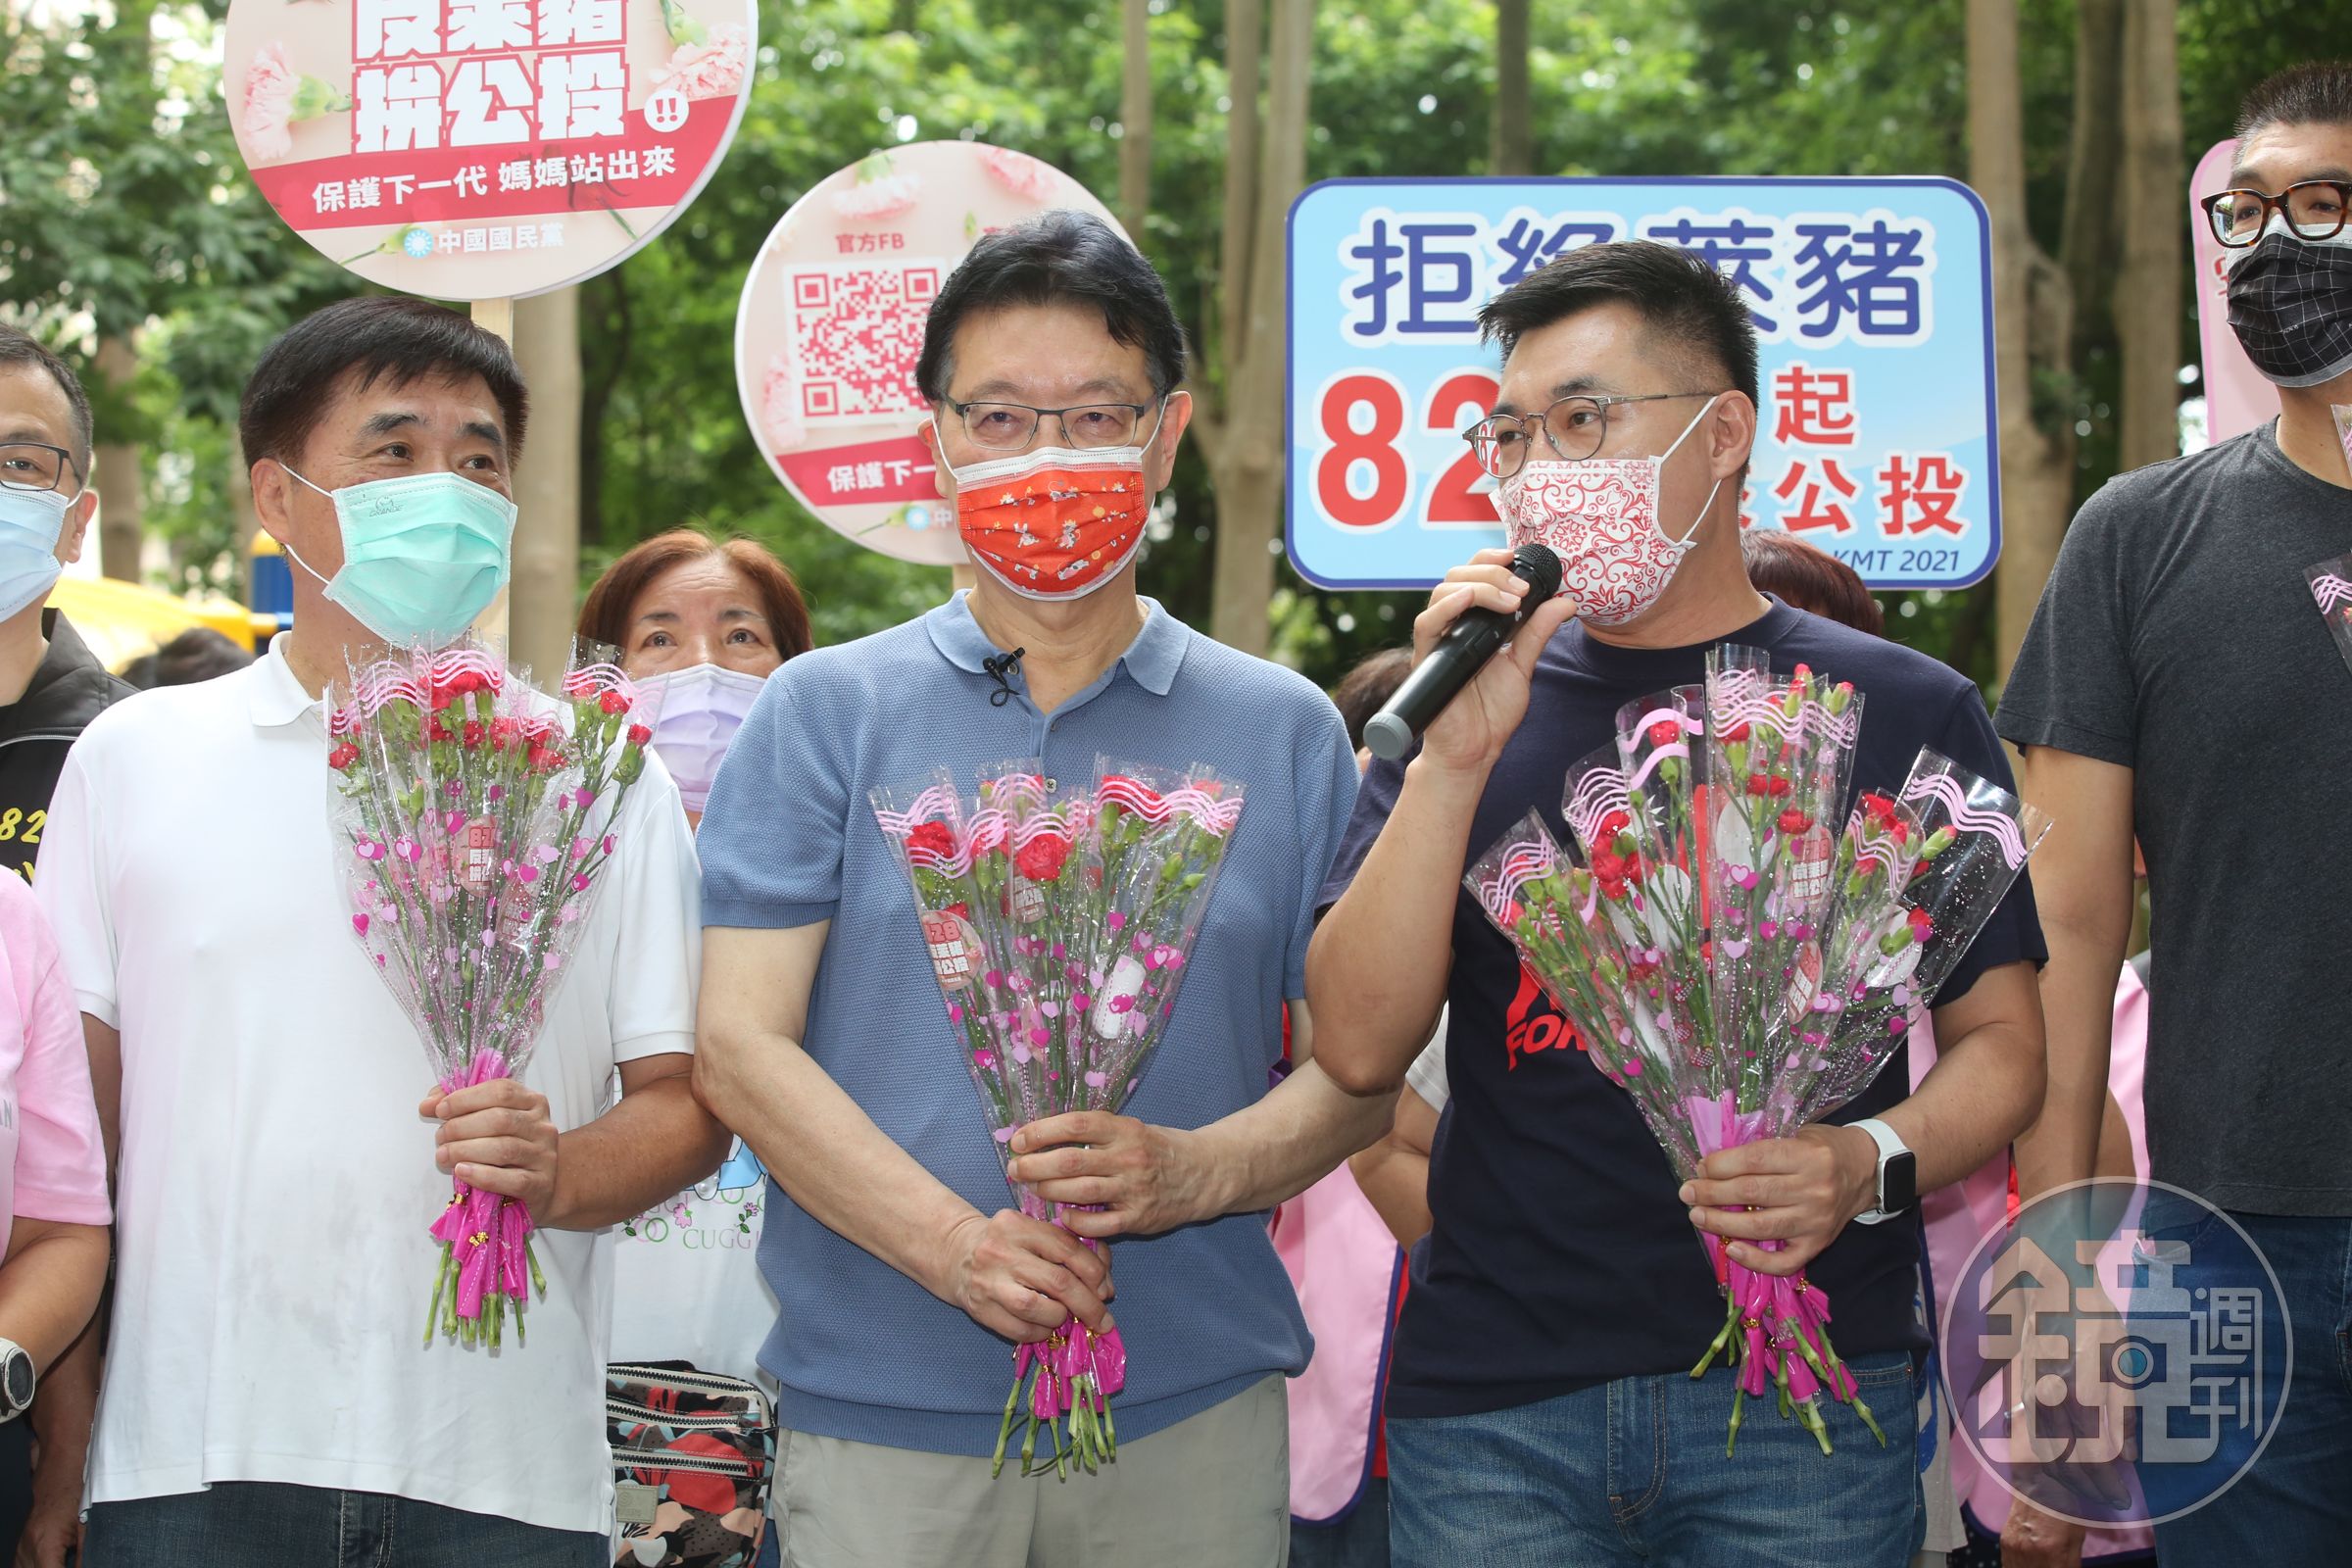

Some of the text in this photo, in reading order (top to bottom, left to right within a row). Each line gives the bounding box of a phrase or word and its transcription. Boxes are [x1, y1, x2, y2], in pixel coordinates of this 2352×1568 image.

[312, 145, 676, 214] 保護下一代 媽媽站出來
[438, 222, 565, 255] 中國國民黨
[835, 232, 905, 254] 官方FB
[1775, 366, 1855, 445] 起
[827, 459, 936, 493] 保護下一
[1740, 455, 1965, 536] 公投
[1899, 550, 1960, 571] 2021
